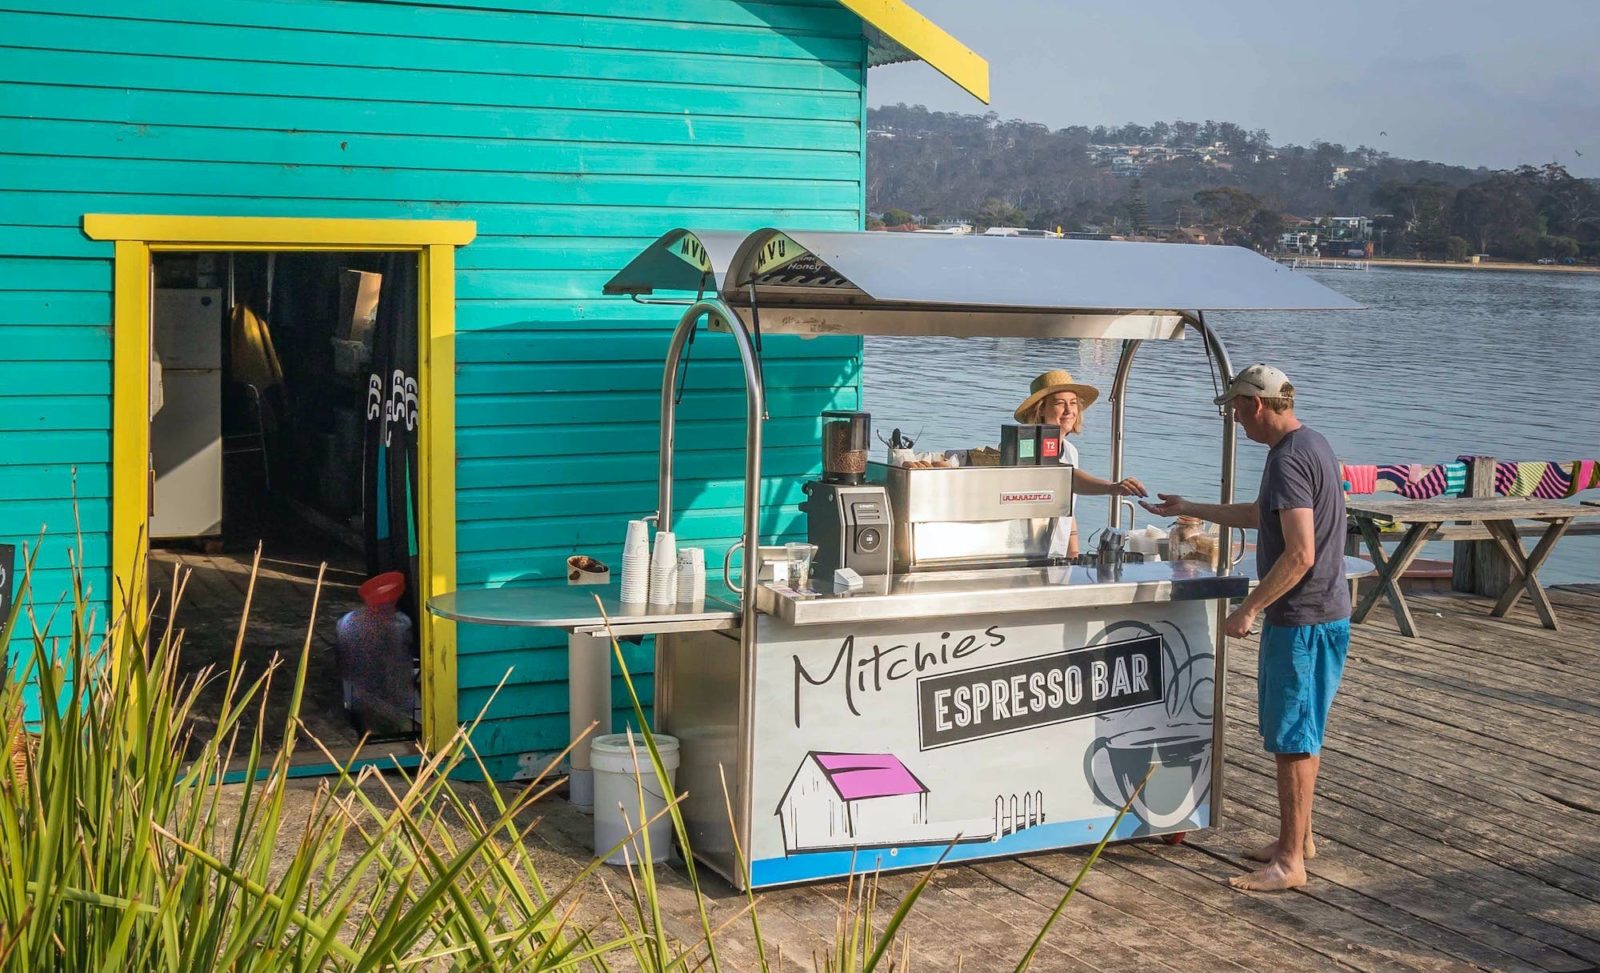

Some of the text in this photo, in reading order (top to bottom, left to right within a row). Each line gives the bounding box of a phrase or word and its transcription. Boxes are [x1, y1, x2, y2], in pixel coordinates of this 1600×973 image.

[1046, 441, 1056, 450] T2
[793, 625, 1006, 729] Mitchies
[934, 653, 1150, 732] ESPRESSO BAR
